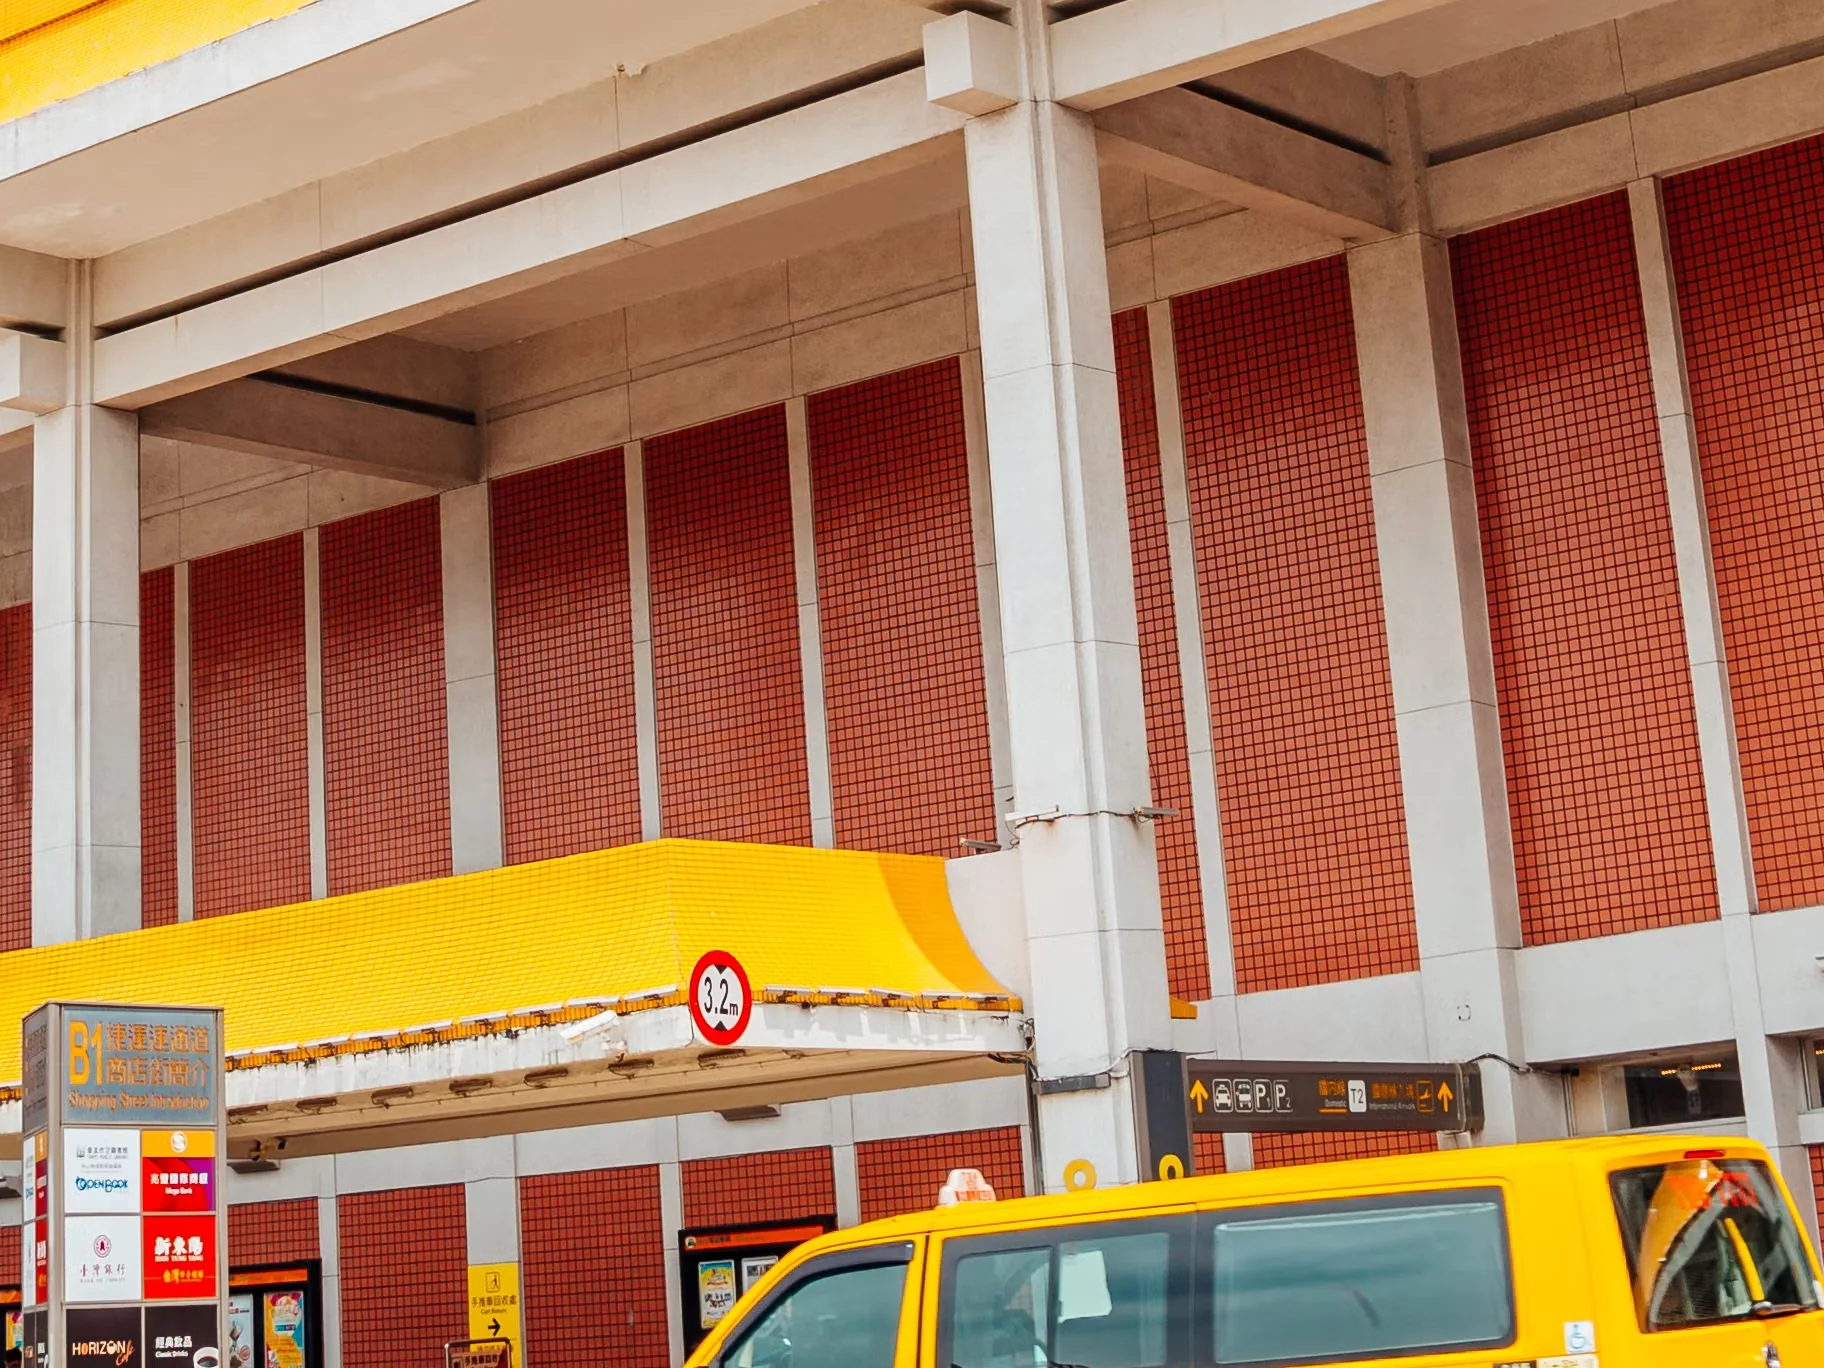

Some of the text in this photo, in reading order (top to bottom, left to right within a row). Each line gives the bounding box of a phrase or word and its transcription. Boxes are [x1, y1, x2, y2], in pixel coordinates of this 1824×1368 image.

[106, 1023, 210, 1054] 捷運連通道
[69, 1019, 103, 1086] B1
[106, 1056, 210, 1087] 商店街簡介
[69, 1090, 118, 1112] Shopping
[120, 1091, 150, 1109] Street
[1350, 1088, 1364, 1104] T2
[154, 1236, 204, 1256] 新東陽
[72, 1339, 126, 1356] HORIZON
